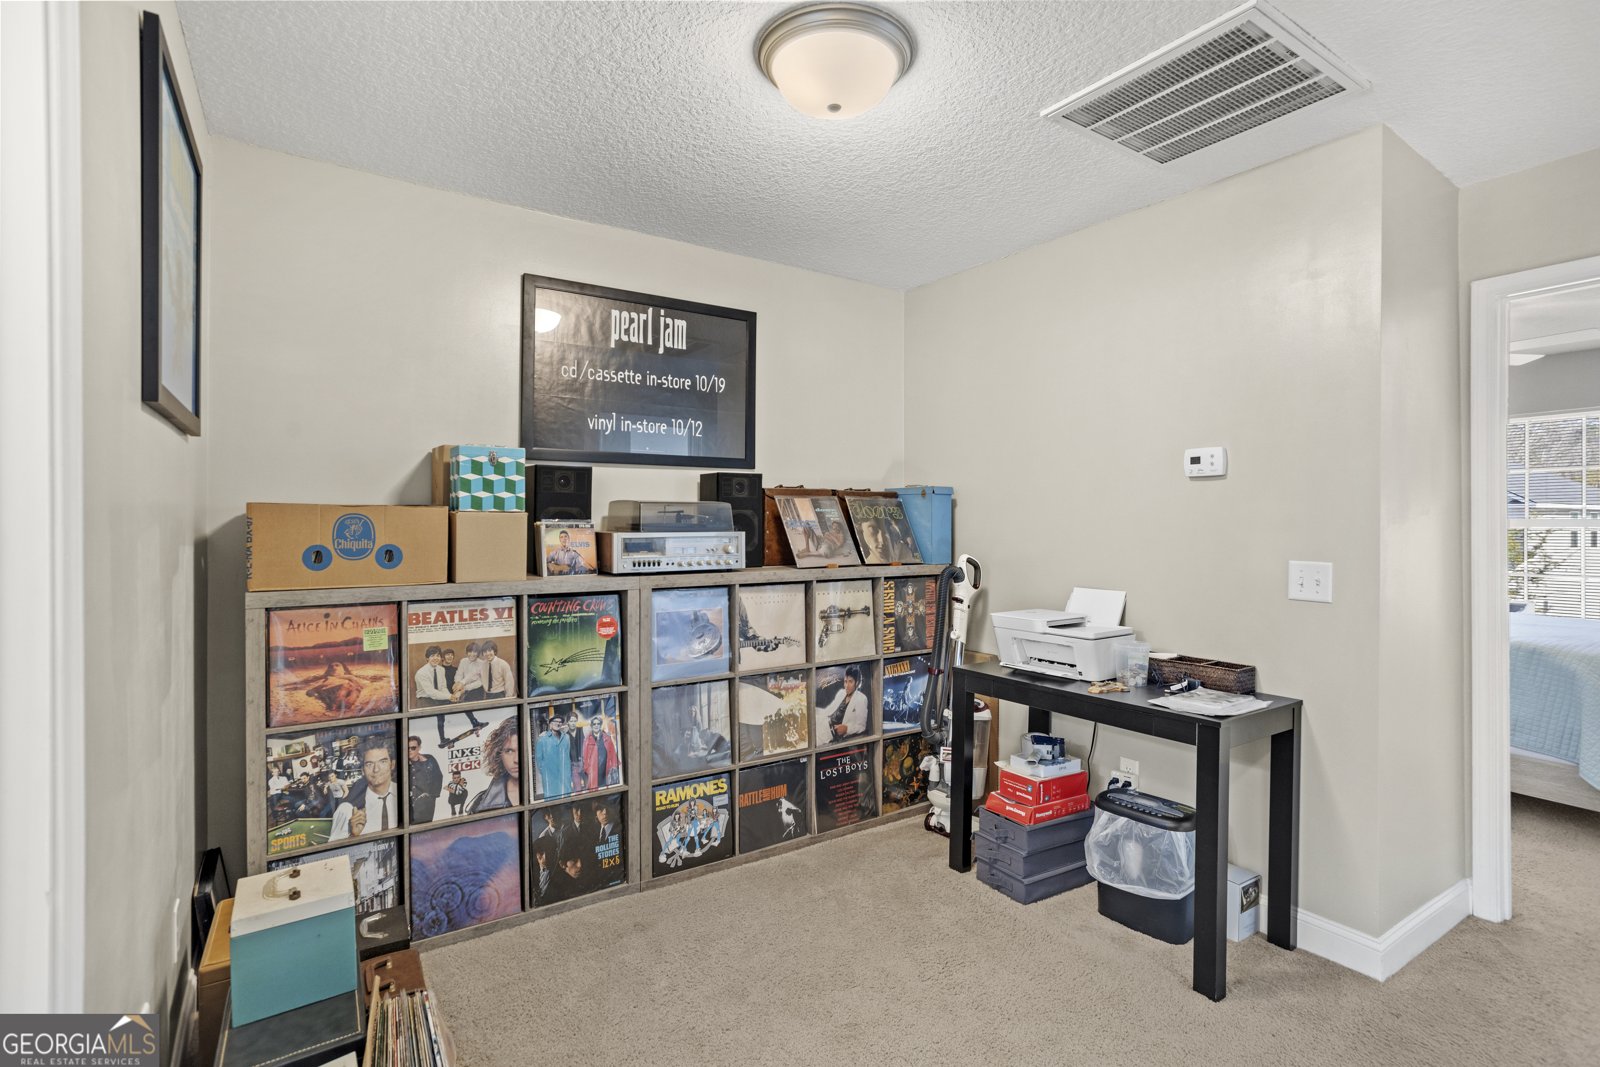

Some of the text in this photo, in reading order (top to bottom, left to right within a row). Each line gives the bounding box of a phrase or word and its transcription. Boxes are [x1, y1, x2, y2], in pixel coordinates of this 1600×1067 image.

[610, 307, 688, 354] pearl jam
[646, 370, 692, 390] in-store
[695, 374, 726, 393] 10/19
[587, 412, 703, 437] vinyl in-store 10/12
[335, 538, 373, 552] Chiquita
[883, 580, 895, 613] ROSES
[408, 607, 490, 626] BEATLES
[493, 606, 514, 620] VI
[530, 599, 582, 615] COUNTING
[286, 619, 321, 633] ALICE
[341, 616, 384, 631] CHAINS
[882, 627, 895, 654] GUNS
[448, 746, 481, 759] INXS
[836, 756, 851, 767] THE
[448, 760, 481, 773] KICK
[820, 760, 868, 780] LOST BOYS
[655, 778, 728, 806] RAMONES
[739, 792, 763, 809] RATTLE
[770, 784, 787, 800] HUM
[271, 833, 307, 852] SPORTS
[595, 841, 619, 853] ROLLING
[608, 834, 619, 842] THE
[597, 848, 620, 860] STONES
